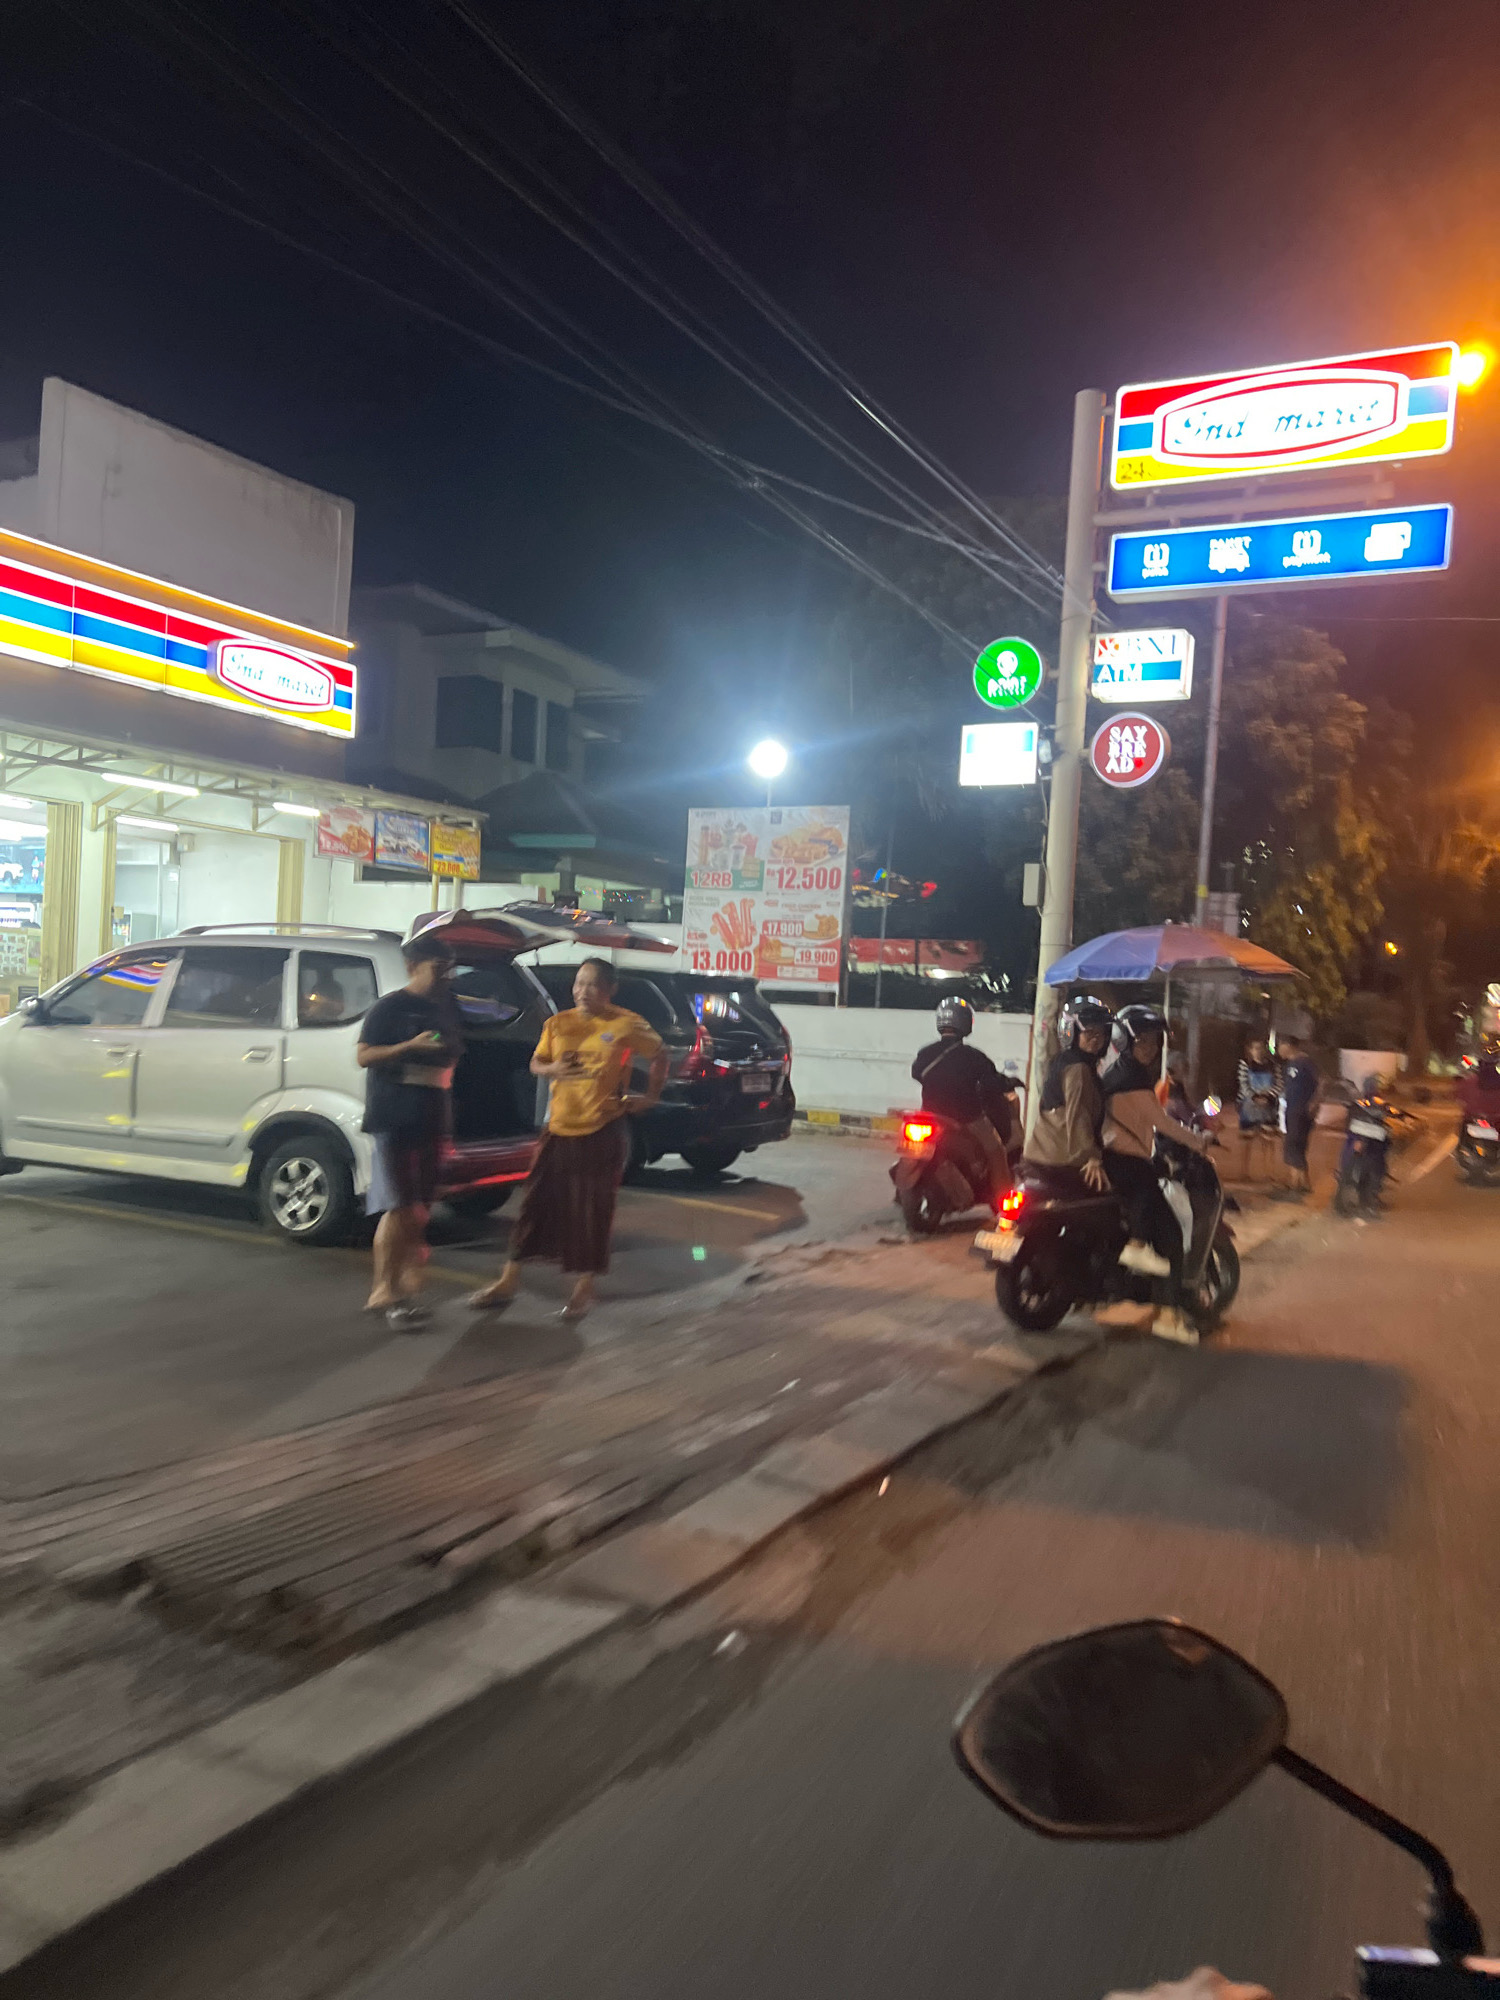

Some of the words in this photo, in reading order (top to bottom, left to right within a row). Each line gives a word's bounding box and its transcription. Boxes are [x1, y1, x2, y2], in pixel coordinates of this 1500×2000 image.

[1096, 662, 1142, 683] ATM
[1108, 725, 1148, 744] SAY
[1104, 756, 1135, 774] AD
[691, 870, 733, 889] 12RB
[777, 866, 842, 891] 12.500
[692, 950, 752, 972] 13.000
